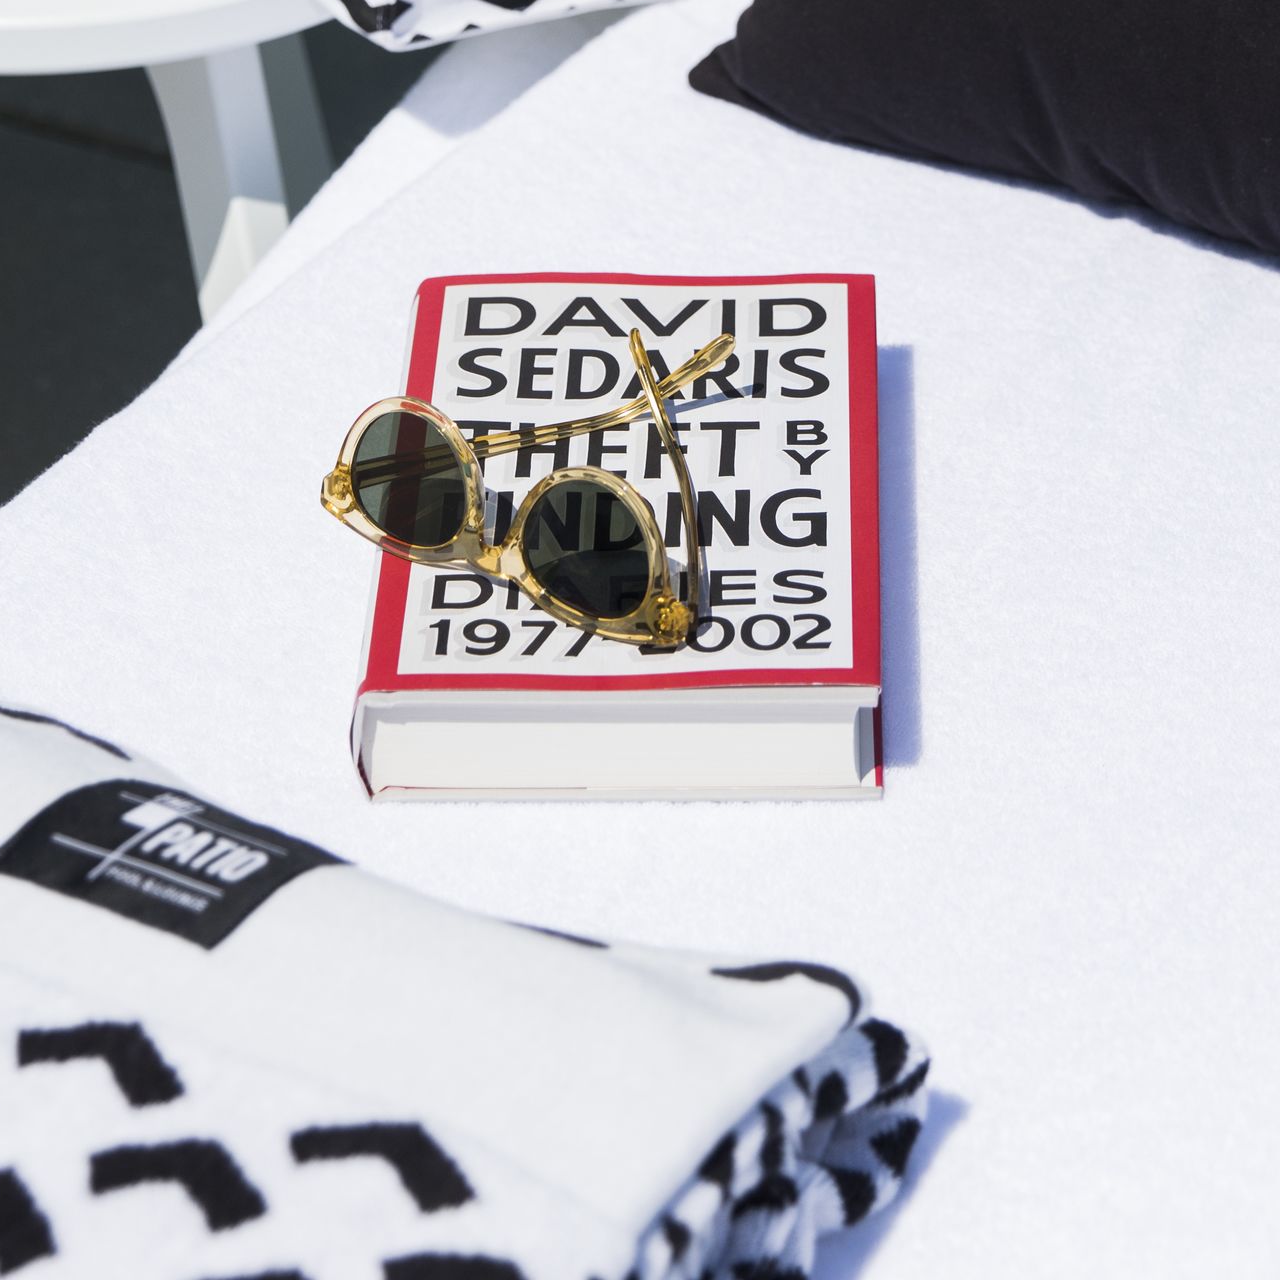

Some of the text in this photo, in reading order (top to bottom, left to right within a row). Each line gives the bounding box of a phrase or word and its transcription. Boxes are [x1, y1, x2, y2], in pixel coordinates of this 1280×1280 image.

[464, 296, 827, 338] DAVID
[456, 346, 830, 400] SEDARIS
[454, 419, 760, 480] THEFT
[435, 488, 828, 553] FINDING
[429, 613, 832, 657] 1977002
[141, 822, 269, 883] PATIO
